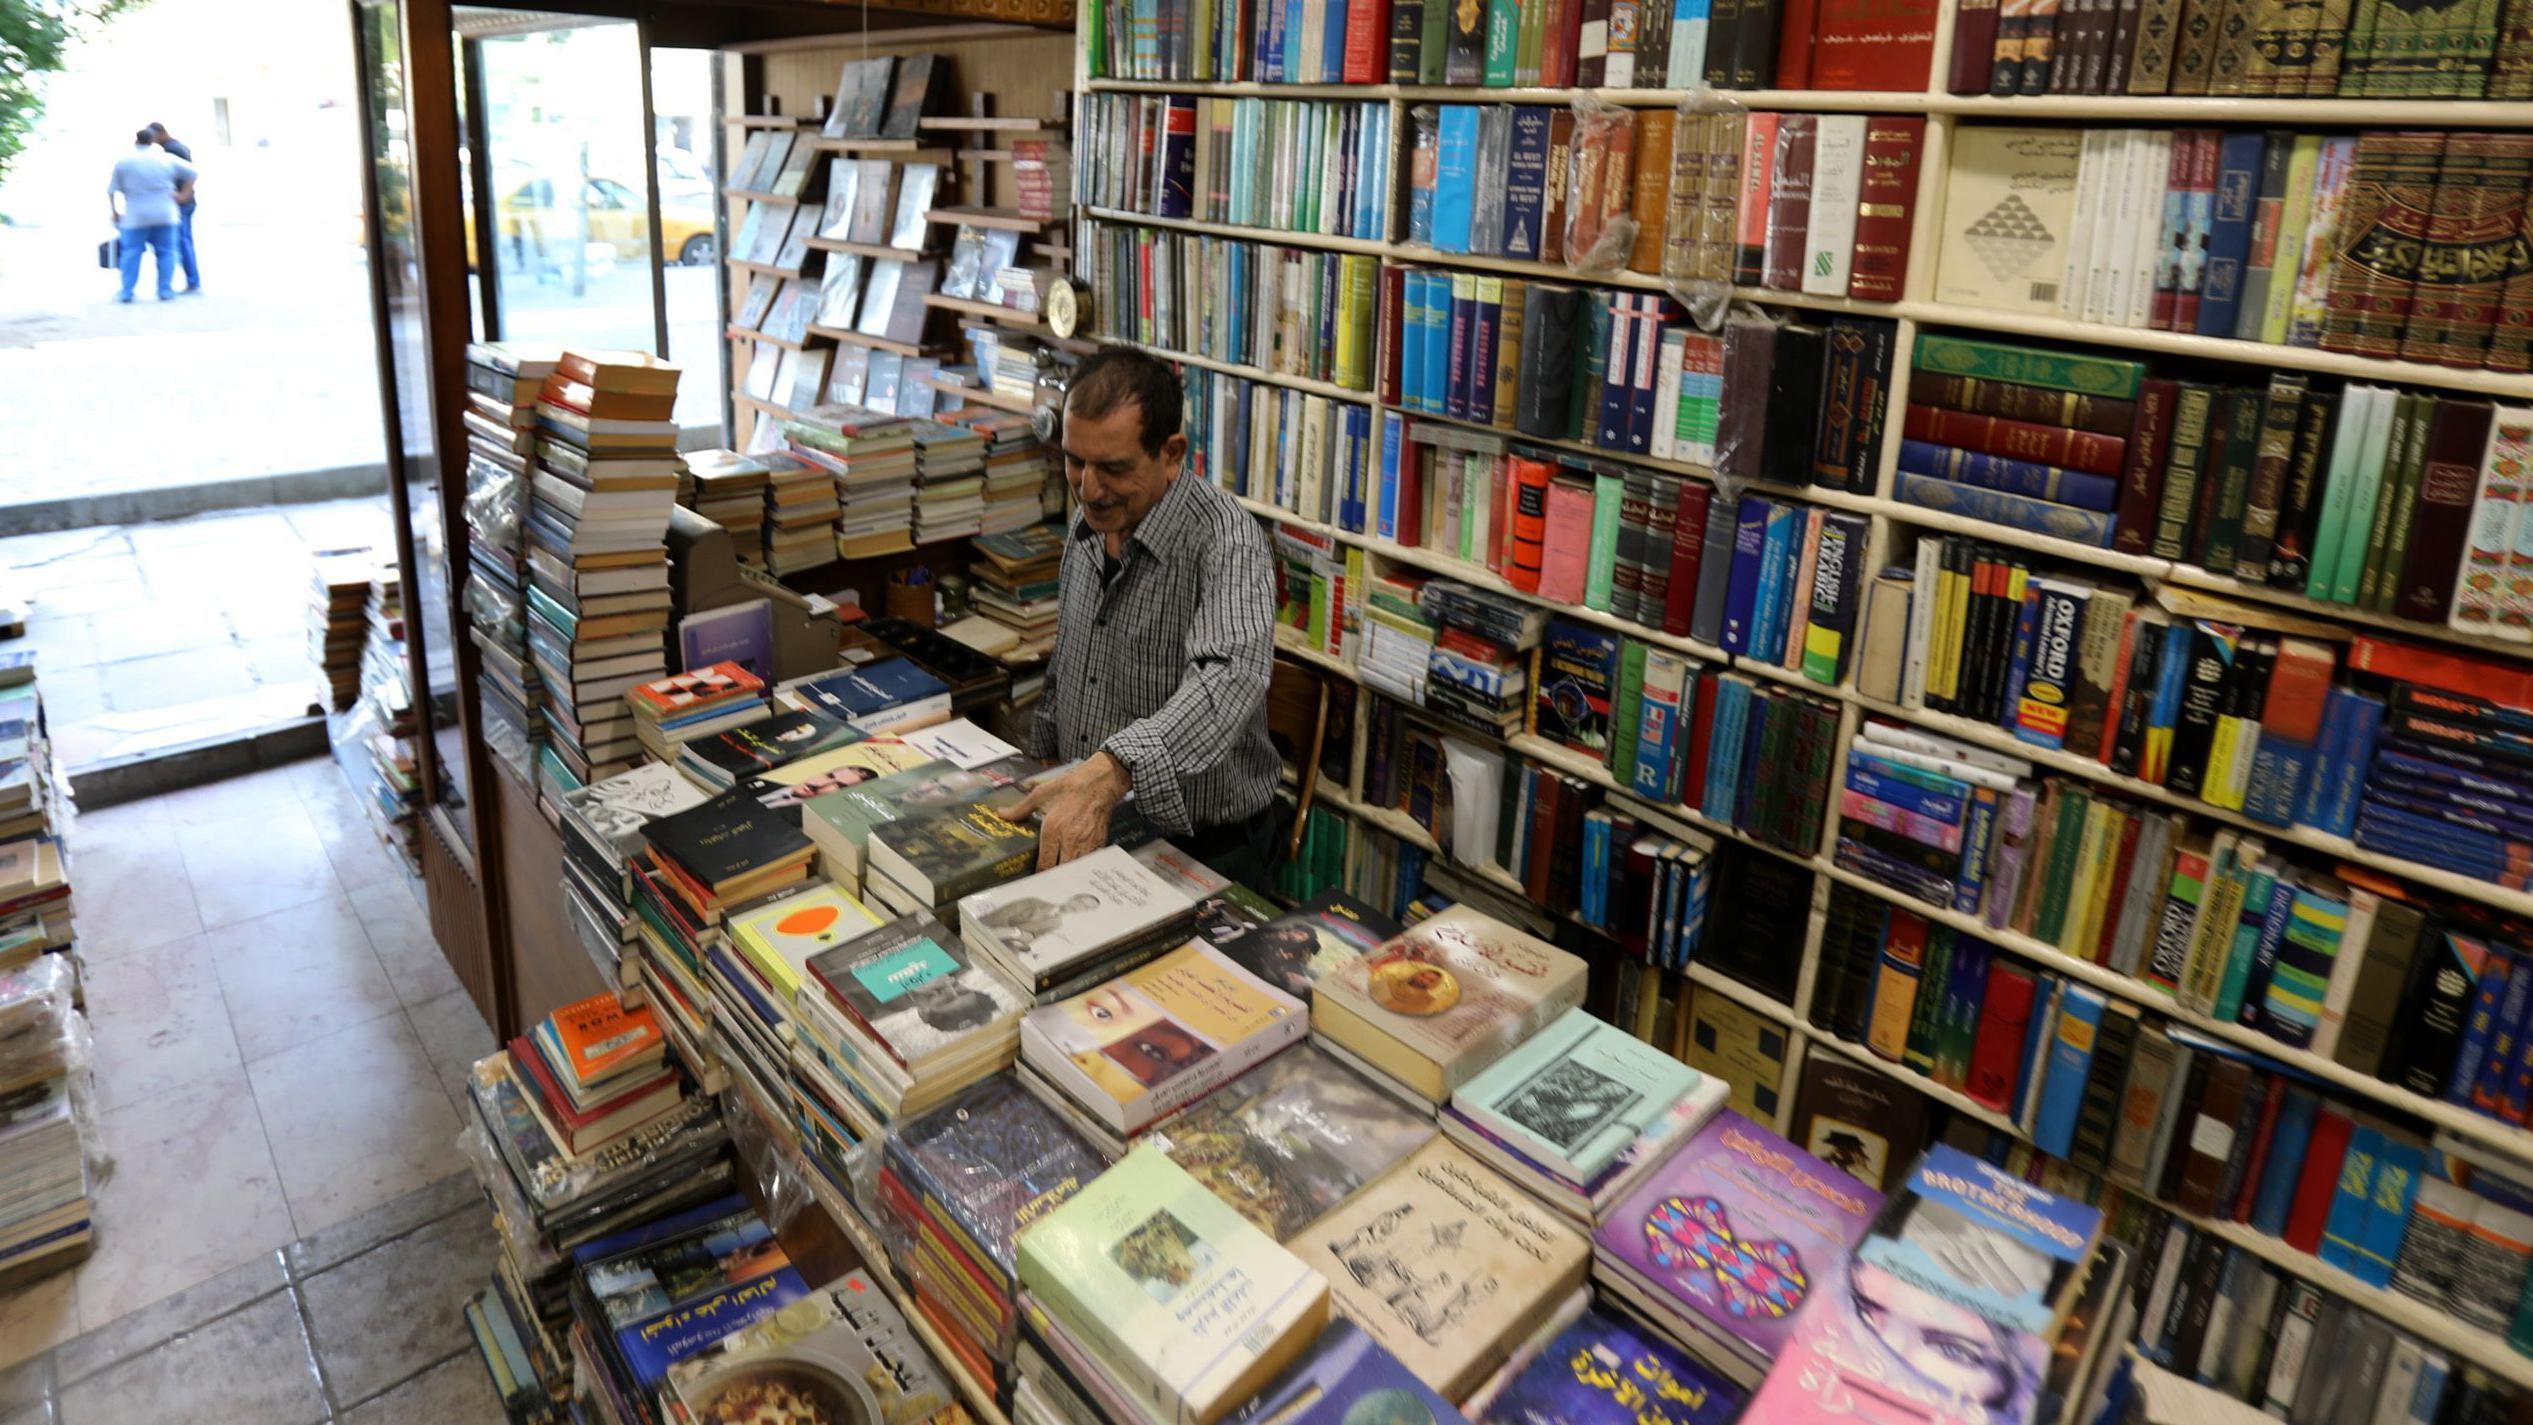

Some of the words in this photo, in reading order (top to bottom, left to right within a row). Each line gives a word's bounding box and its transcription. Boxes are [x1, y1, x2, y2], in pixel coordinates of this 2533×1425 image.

[1811, 534, 1837, 606] ARABIC
[1826, 537, 1847, 607] ENGLISH
[2046, 599, 2077, 680] OXFORD
[2256, 887, 2292, 968] DICTIONARY
